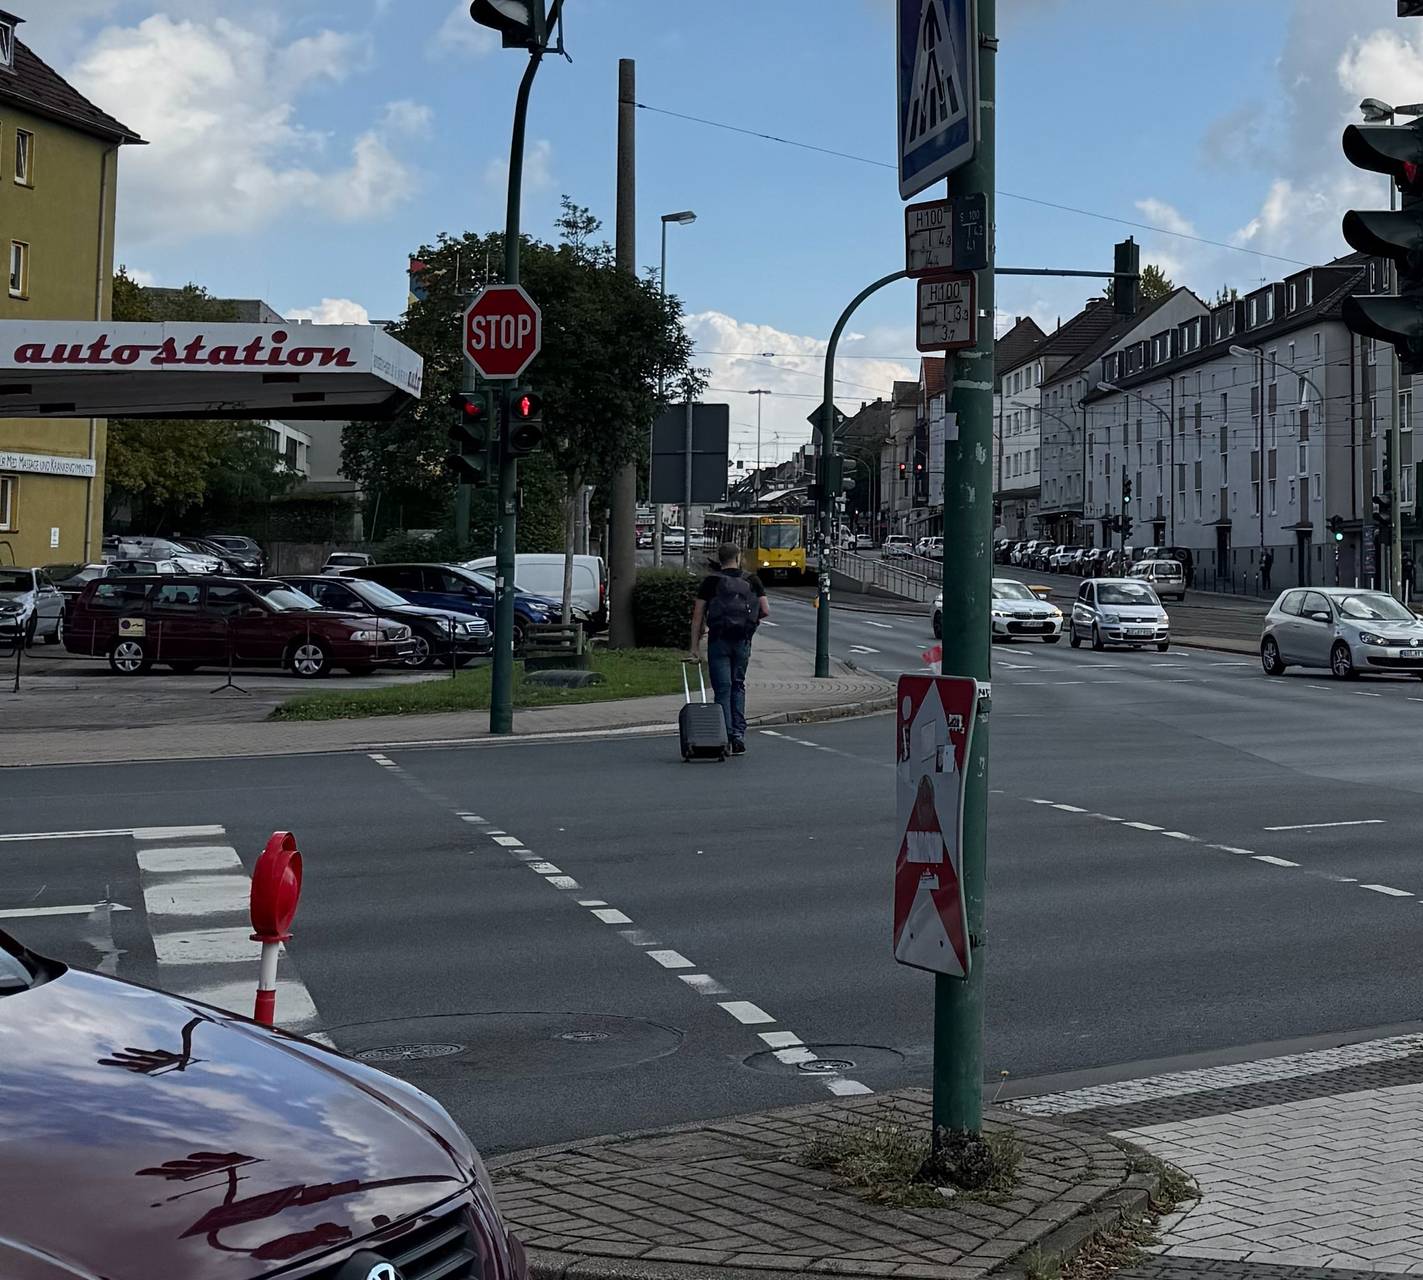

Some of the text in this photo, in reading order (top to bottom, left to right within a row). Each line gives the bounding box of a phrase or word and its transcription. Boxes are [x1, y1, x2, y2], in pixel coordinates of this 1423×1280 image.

[916, 208, 943, 228] H100
[930, 282, 960, 301] H100
[472, 314, 532, 350] STOP
[14, 330, 357, 367] autostation
